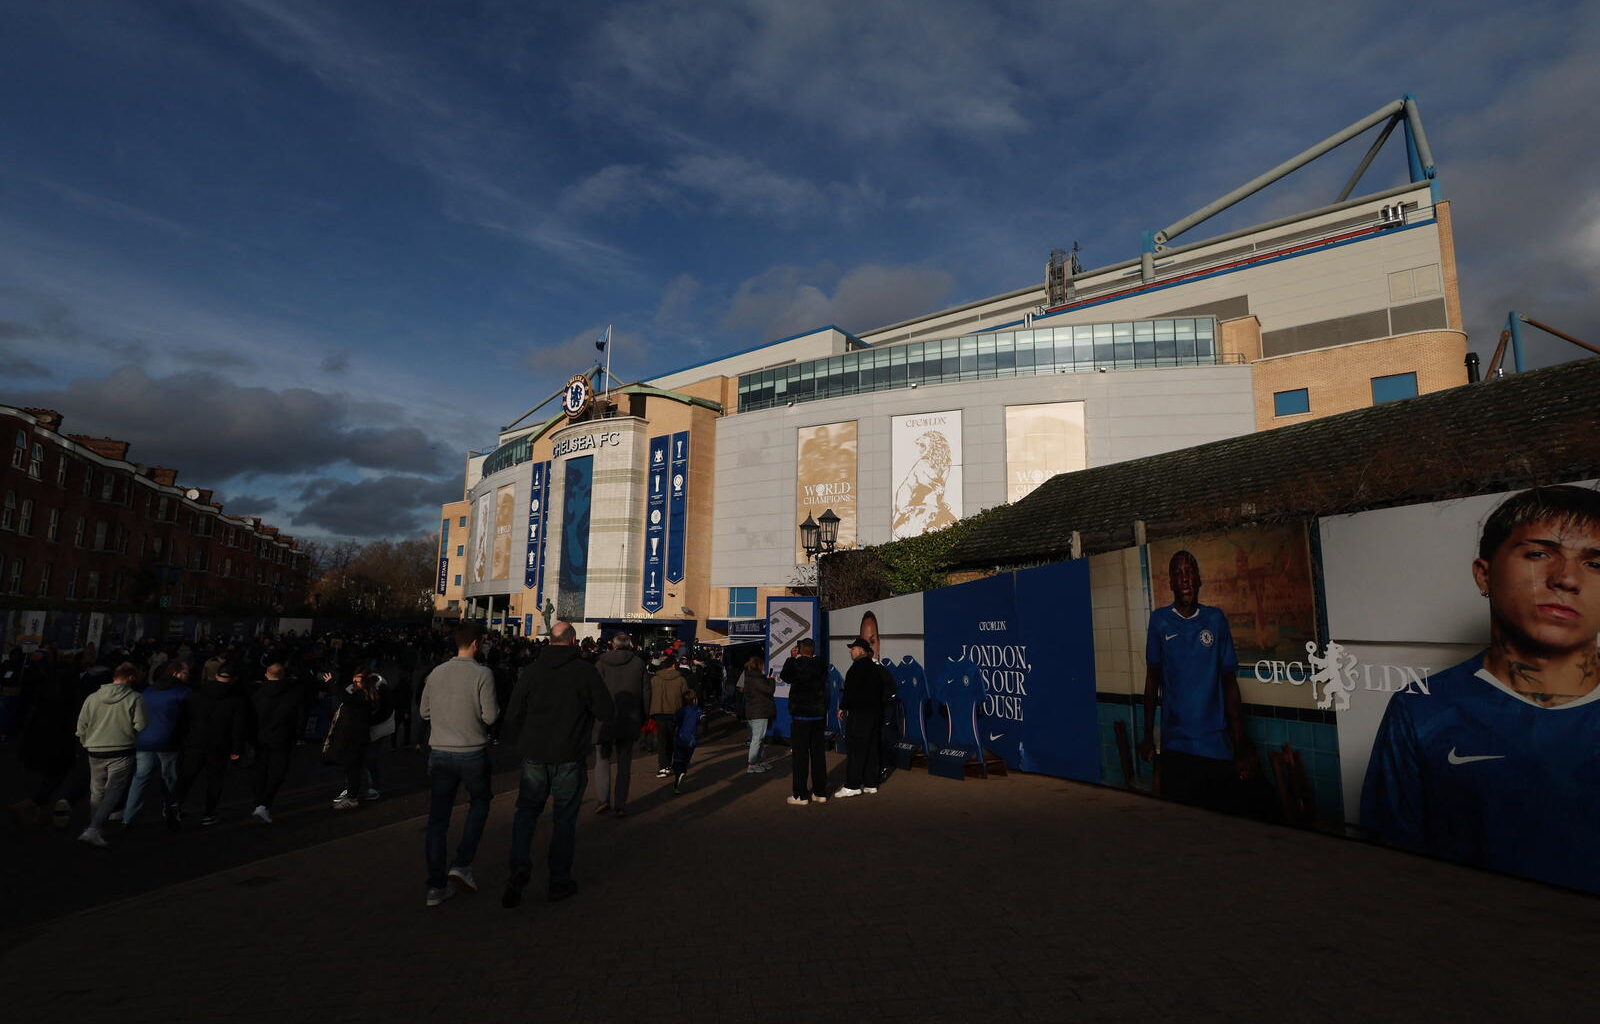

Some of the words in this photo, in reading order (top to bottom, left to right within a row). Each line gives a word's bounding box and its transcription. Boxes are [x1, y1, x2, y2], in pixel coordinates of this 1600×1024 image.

[553, 434, 596, 459] CHELSEA
[600, 431, 620, 448] FC
[803, 494, 851, 505] CHAMPIONS
[804, 482, 851, 496] WORLD
[992, 670, 1028, 696] OUR
[1254, 660, 1307, 686] CFC
[1363, 664, 1431, 696] LDN
[983, 693, 1024, 721] OUSE
